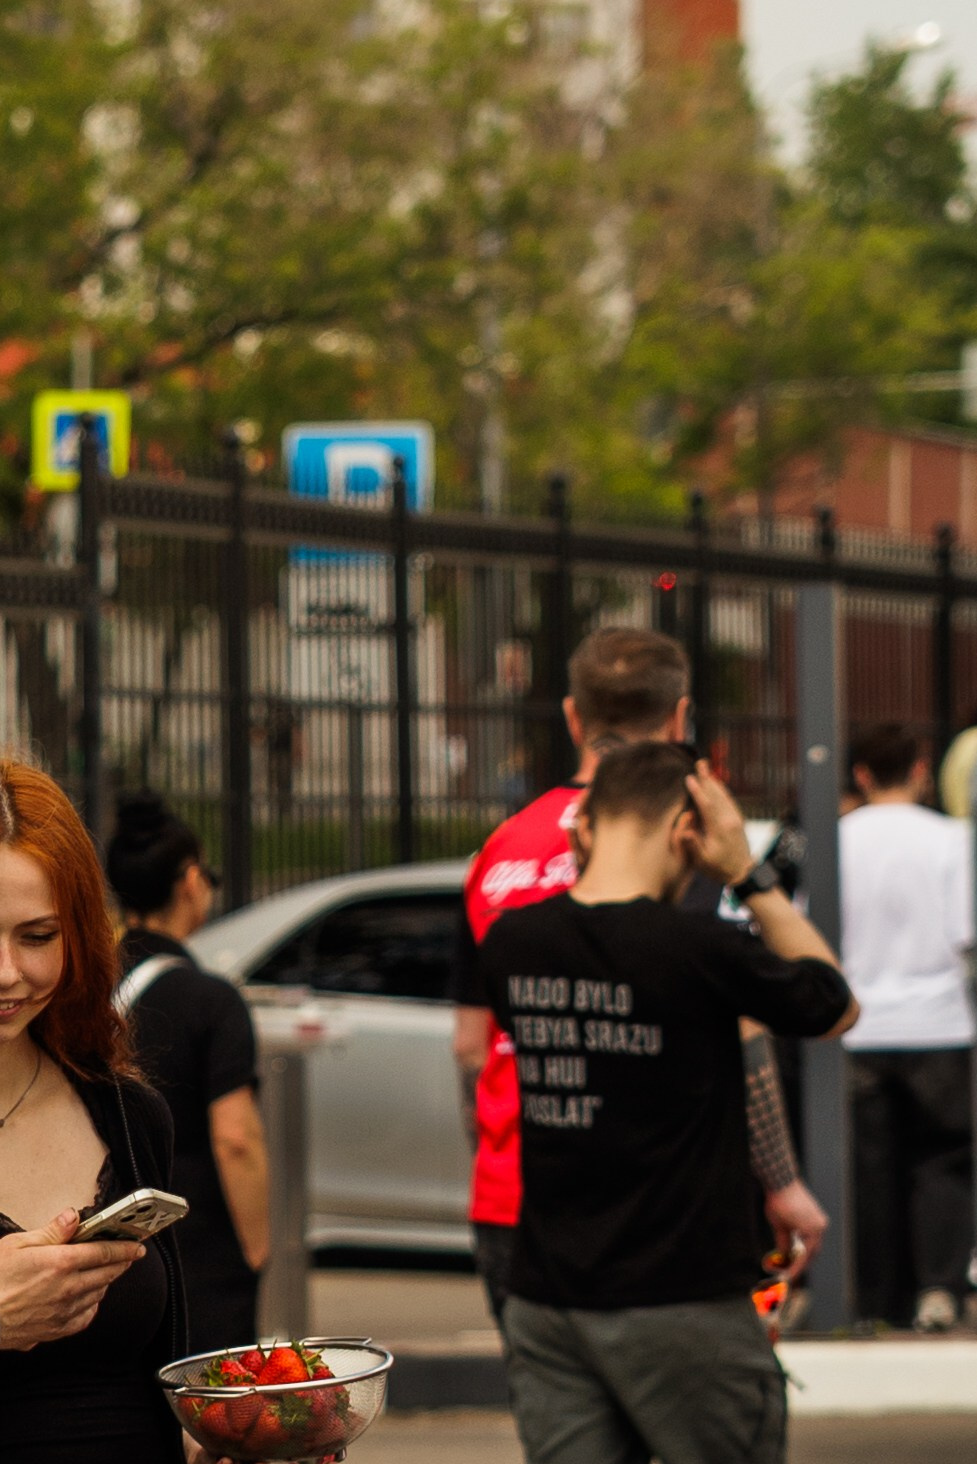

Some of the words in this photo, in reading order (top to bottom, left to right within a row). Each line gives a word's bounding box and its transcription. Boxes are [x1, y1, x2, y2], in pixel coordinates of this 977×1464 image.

[508, 974, 571, 1010] NADO
[574, 979, 634, 1017] BYLO
[511, 1014, 580, 1049] TEBYA
[583, 1019, 664, 1056] SRAZU
